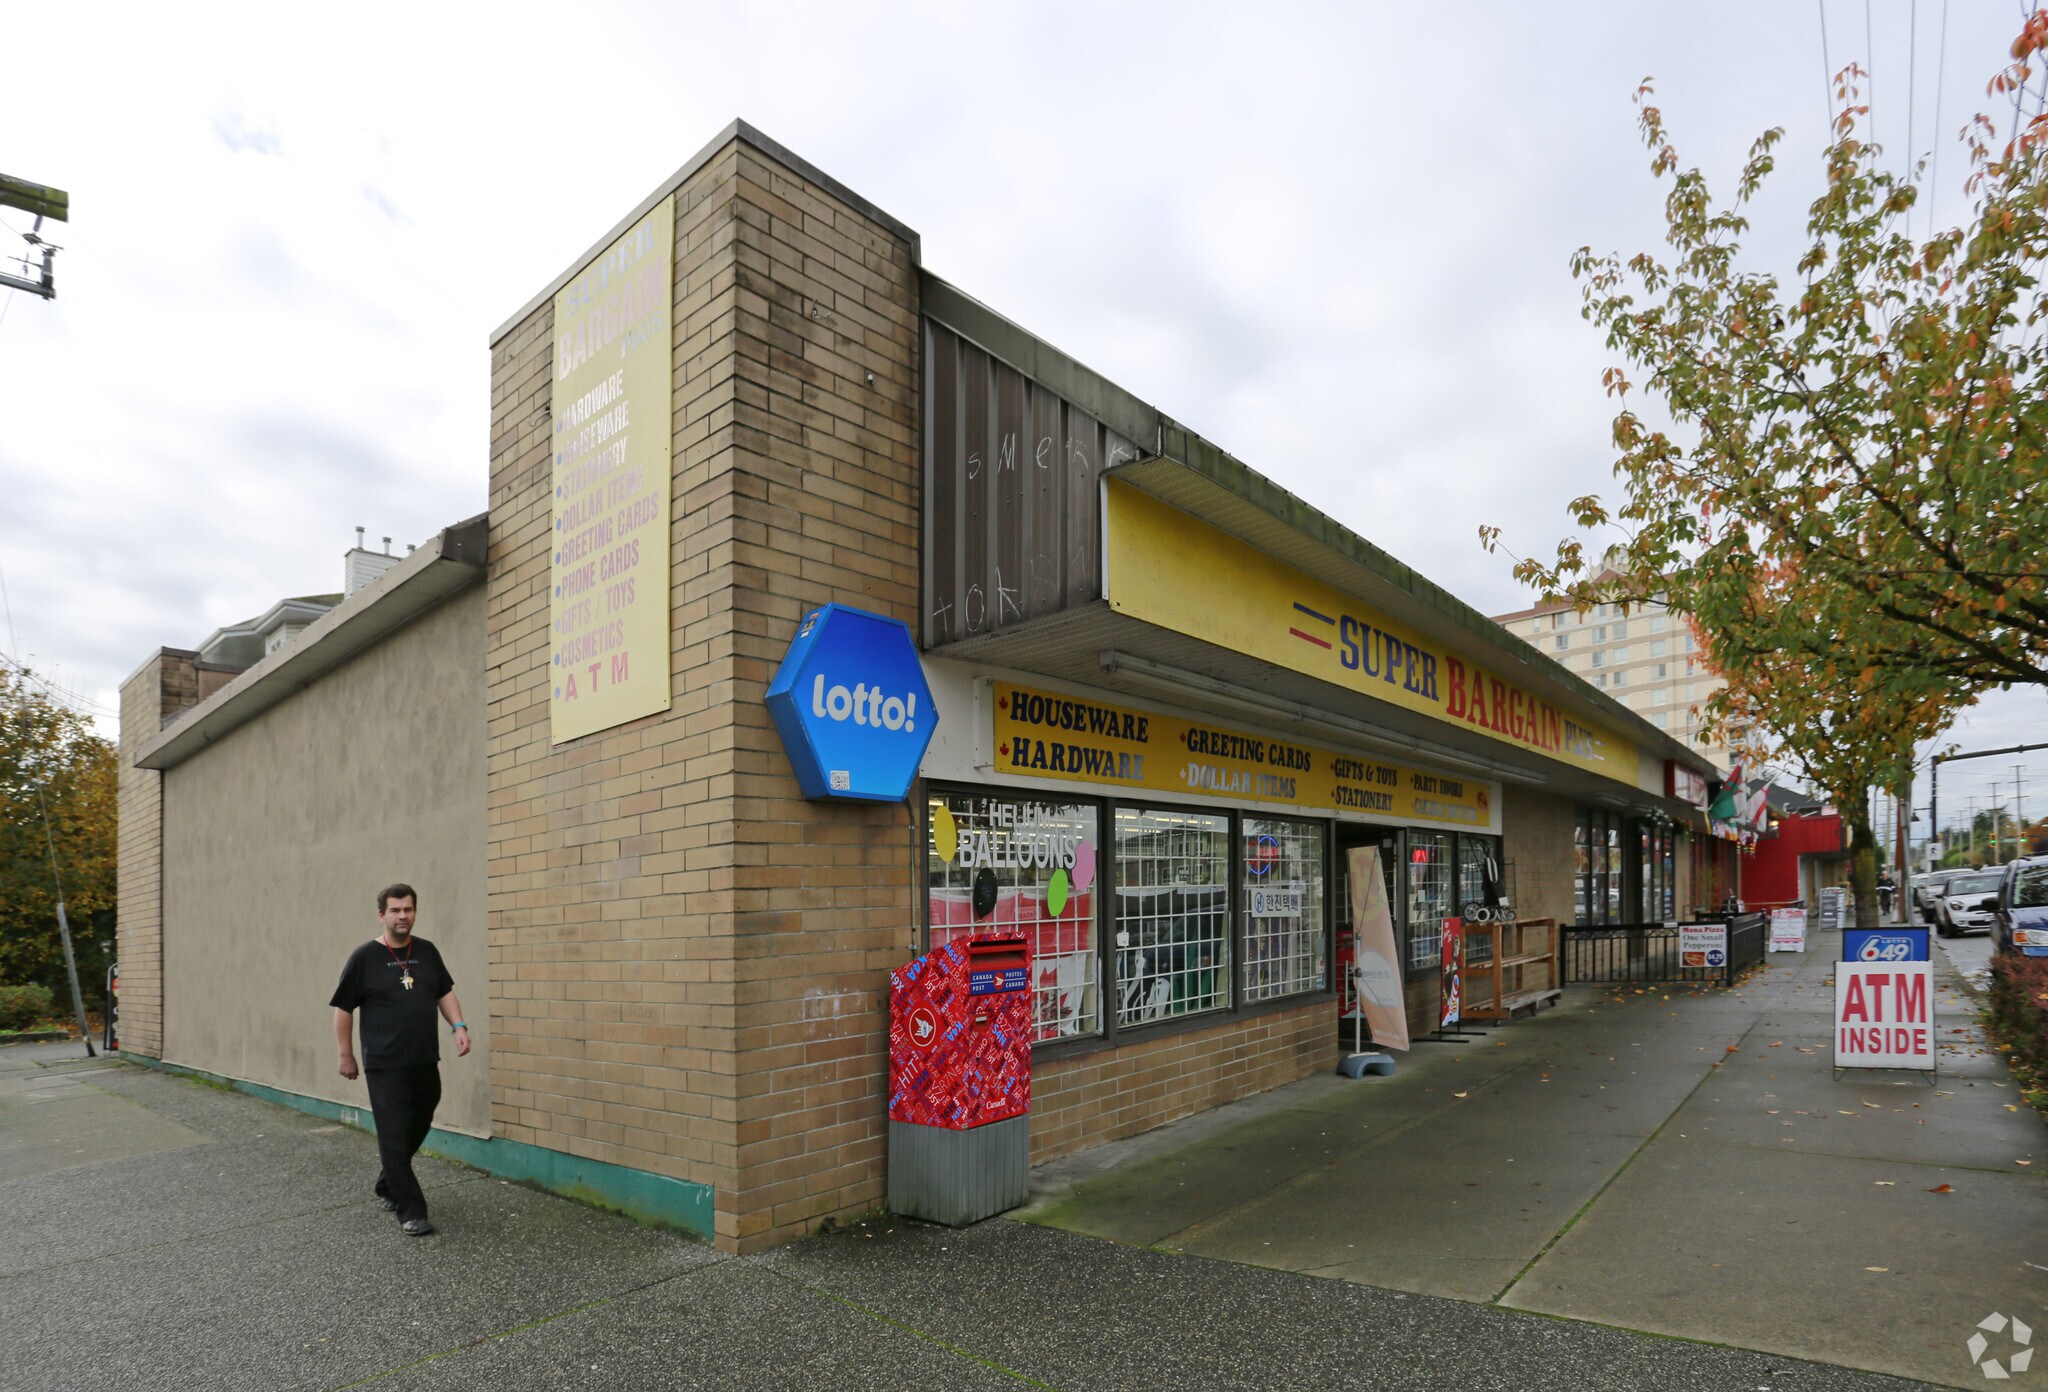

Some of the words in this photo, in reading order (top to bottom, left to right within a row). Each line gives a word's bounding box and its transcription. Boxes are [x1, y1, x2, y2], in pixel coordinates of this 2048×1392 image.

[558, 255, 663, 382] BARGAIN
[563, 368, 623, 434] HARDWARE
[562, 487, 603, 536] DOLLAR
[606, 464, 645, 509] ITEMS
[561, 516, 613, 568] GREETING
[617, 490, 660, 537] CARDS
[561, 560, 596, 602] PHONE
[600, 538, 640, 582] CARDS
[561, 598, 591, 636] GIFTS
[605, 576, 636, 615] TOYS
[560, 618, 624, 669] COSMETICS
[812, 673, 917, 733] lotto!
[1340, 613, 1440, 702] SUPER
[1445, 655, 1562, 755] BARGAIN
[1564, 719, 1595, 760] PLUS
[1010, 691, 1149, 744] HOUSEWARE
[1011, 737, 1145, 781] HARDWARE
[1186, 727, 1265, 764] GREETING
[1268, 744, 1311, 773] CARDS
[1334, 758, 1364, 782] GIFTS
[1365, 765, 1374, 783] &
[1376, 767, 1398, 787] TOYS
[1187, 763, 1251, 794] DOLLAR
[1255, 773, 1296, 799] ITEMS
[1335, 785, 1393, 811] STATIONERY
[1414, 773, 1438, 794] PARTY
[989, 802, 1051, 828] HELIUM
[960, 829, 1077, 870] BALLOONS
[1683, 942, 1723, 950] Pepperoni
[1842, 973, 1926, 1023] ATM
[1841, 1027, 1927, 1055] INSIDE
[898, 1058, 918, 1089] H1T
